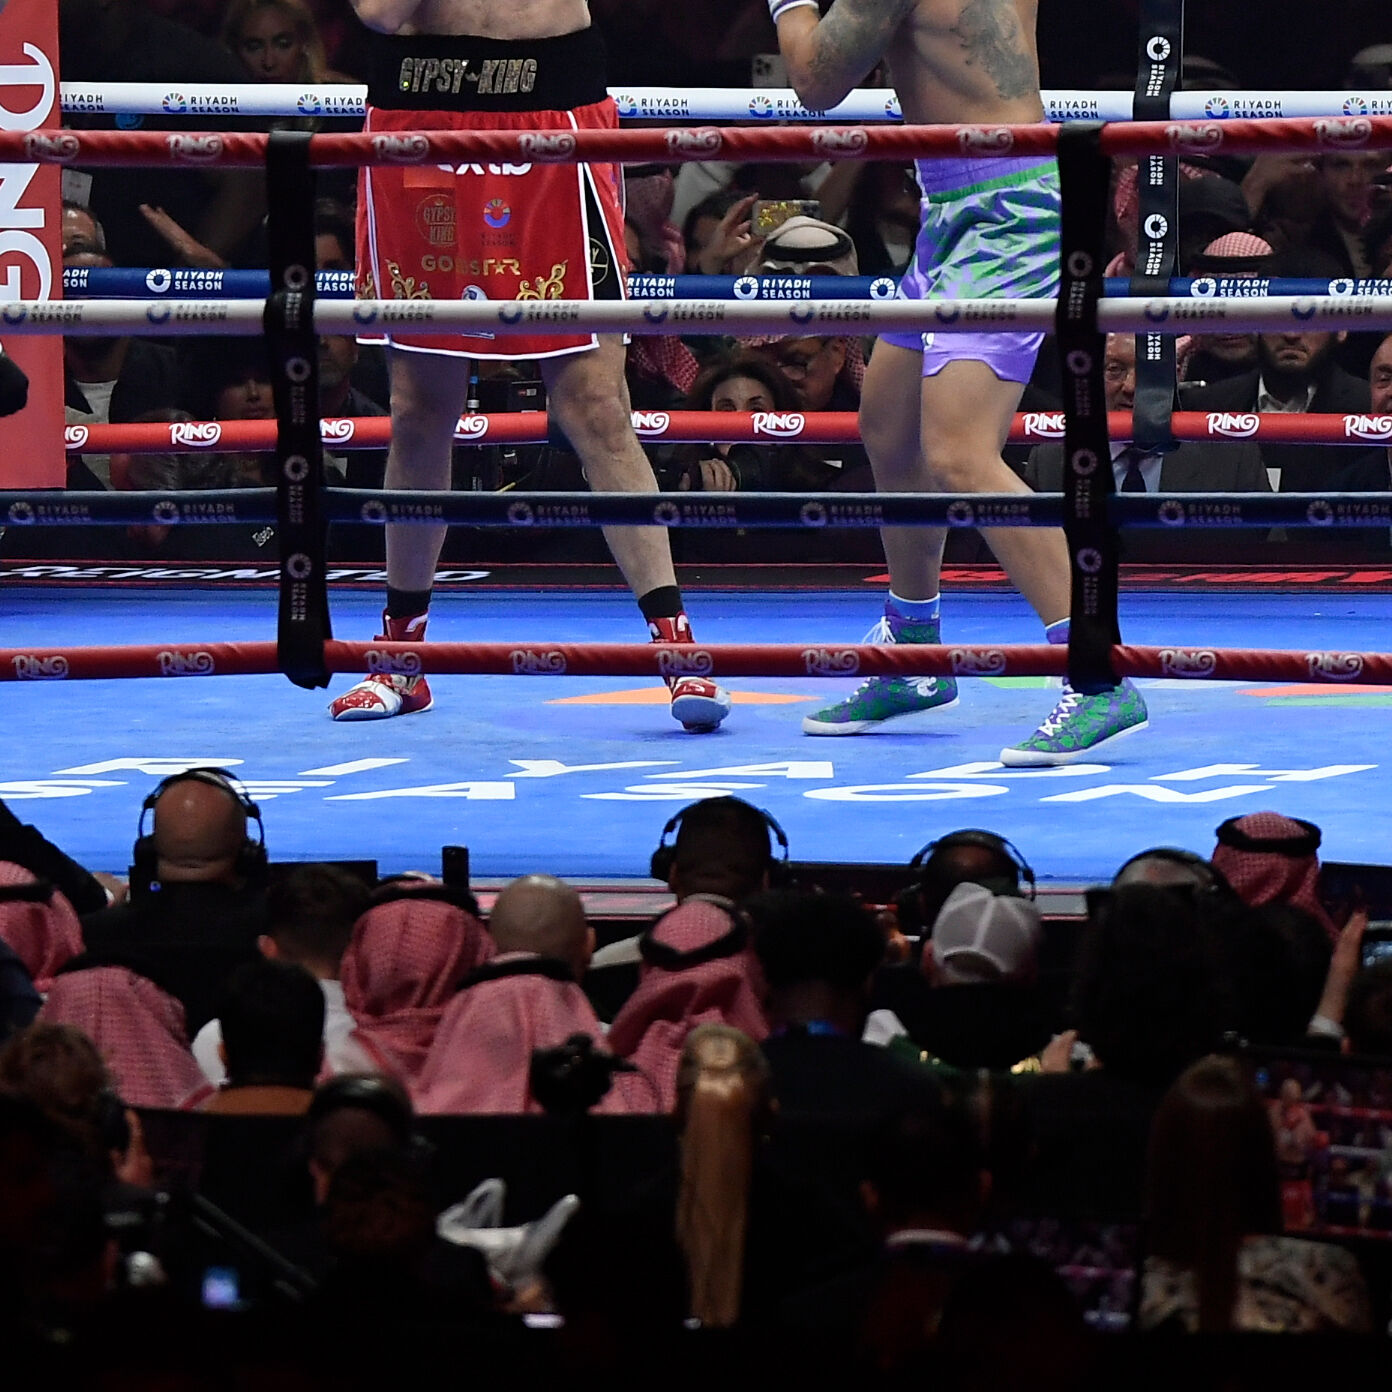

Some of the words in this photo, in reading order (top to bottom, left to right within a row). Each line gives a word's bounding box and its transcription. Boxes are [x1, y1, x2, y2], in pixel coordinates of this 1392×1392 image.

[477, 58, 538, 94] KING
[1146, 64, 1157, 97] SEASON
[1153, 64, 1165, 97] RIYADH
[190, 96, 238, 106] RIYADH
[324, 97, 363, 106] RIYAD
[641, 98, 688, 108] RIYADH
[1049, 100, 1098, 110] RIYADH
[1233, 100, 1282, 110] RIYADH
[191, 106, 240, 114] SEASON
[642, 108, 690, 116] SEASON
[1050, 110, 1099, 119] SEASON
[1234, 110, 1283, 118] SEASON
[1145, 242, 1156, 276] SEASON
[1152, 242, 1163, 276] RIYADH
[175, 271, 223, 281] RIYADH
[174, 281, 222, 291] SEASON
[316, 282, 355, 291] EASON
[627, 277, 675, 287] RIYADH
[763, 279, 811, 289] RIYADH
[1220, 279, 1269, 288] RIYADH
[626, 287, 674, 297] SEASON
[762, 289, 810, 299] SEASON
[1220, 288, 1268, 297] SEASON
[751, 412, 805, 437] RING
[1205, 412, 1259, 438] RING
[169, 421, 221, 446] RING
